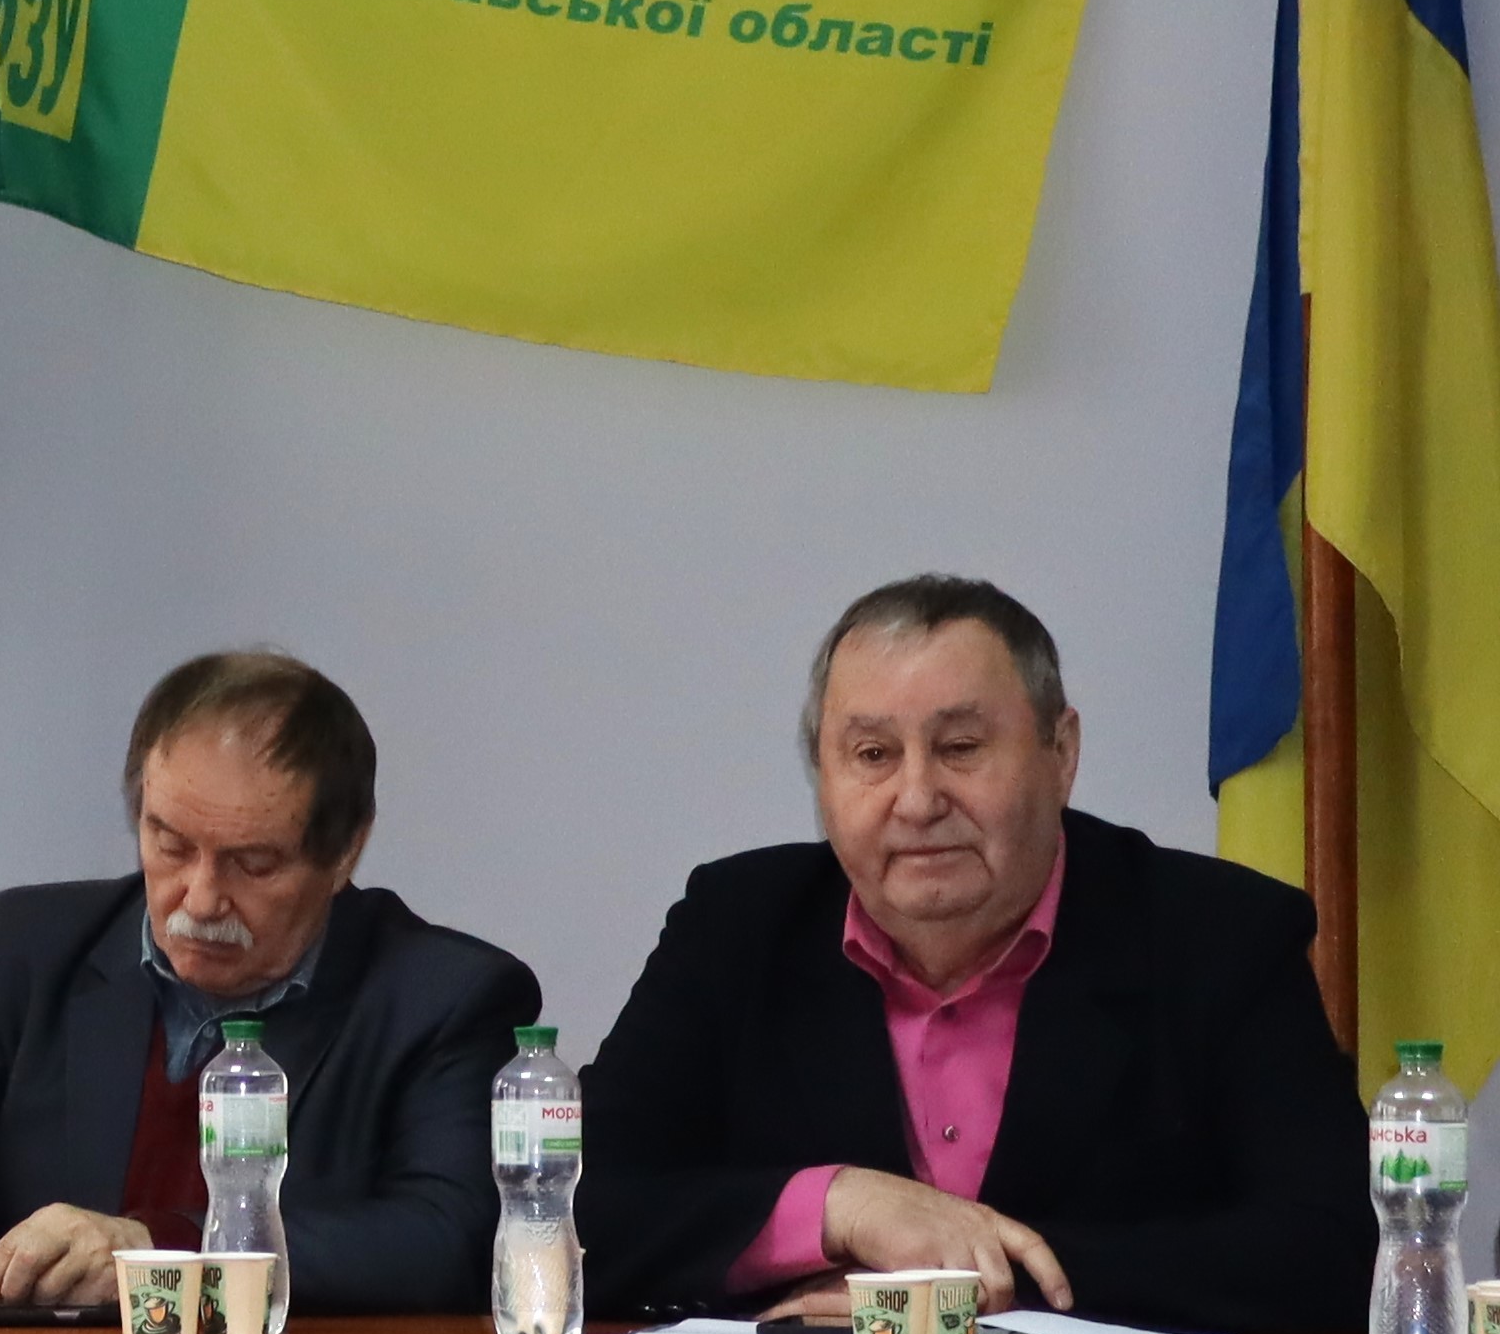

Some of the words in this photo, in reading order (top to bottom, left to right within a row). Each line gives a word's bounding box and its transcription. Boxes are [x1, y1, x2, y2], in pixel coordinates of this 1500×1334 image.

[728, 3, 995, 66] області
[150, 1269, 182, 1292] SHOP
[876, 1290, 909, 1313] SHOP
